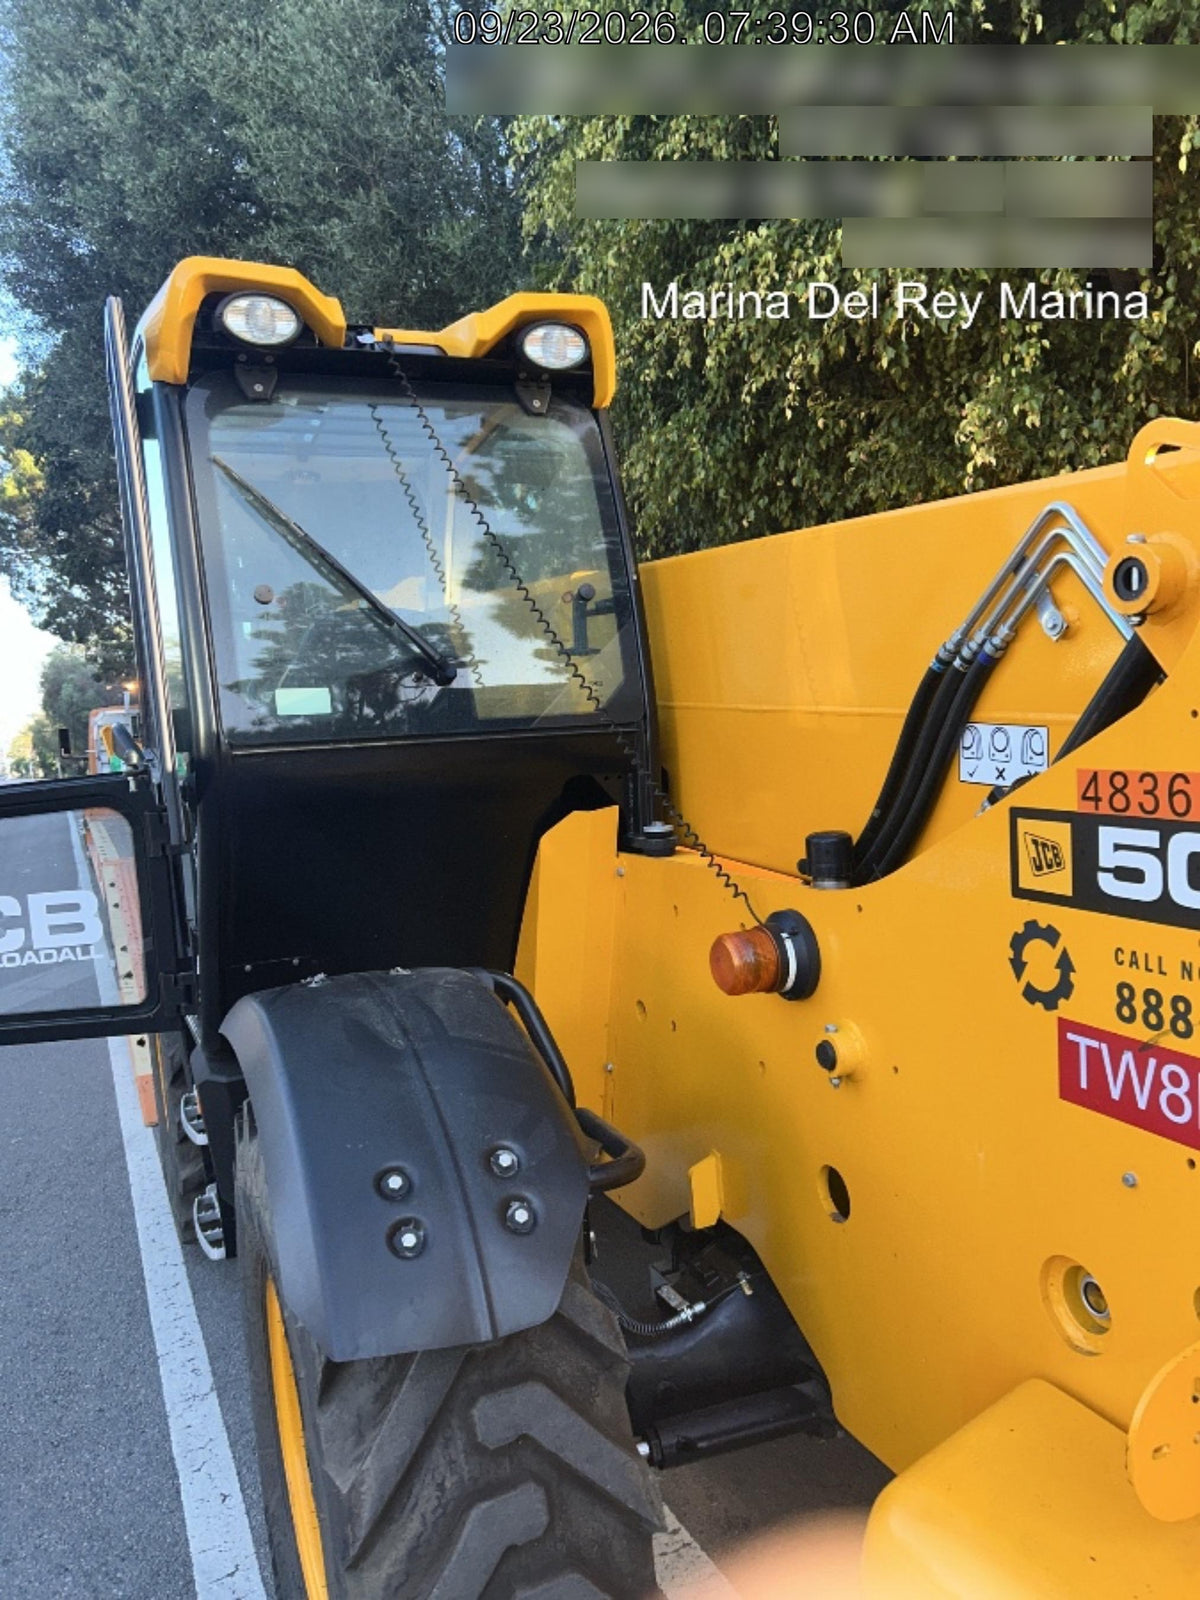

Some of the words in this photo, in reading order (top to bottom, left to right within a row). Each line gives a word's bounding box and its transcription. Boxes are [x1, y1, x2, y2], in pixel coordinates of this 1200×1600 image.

[1081, 771, 1192, 817] 4836
[1030, 838, 1063, 873] JCB
[0, 944, 104, 968] OADALL
[1114, 947, 1167, 976] CALL
[1180, 959, 1200, 982] N
[1115, 981, 1194, 1039] 888
[1066, 1031, 1200, 1129] TW8
